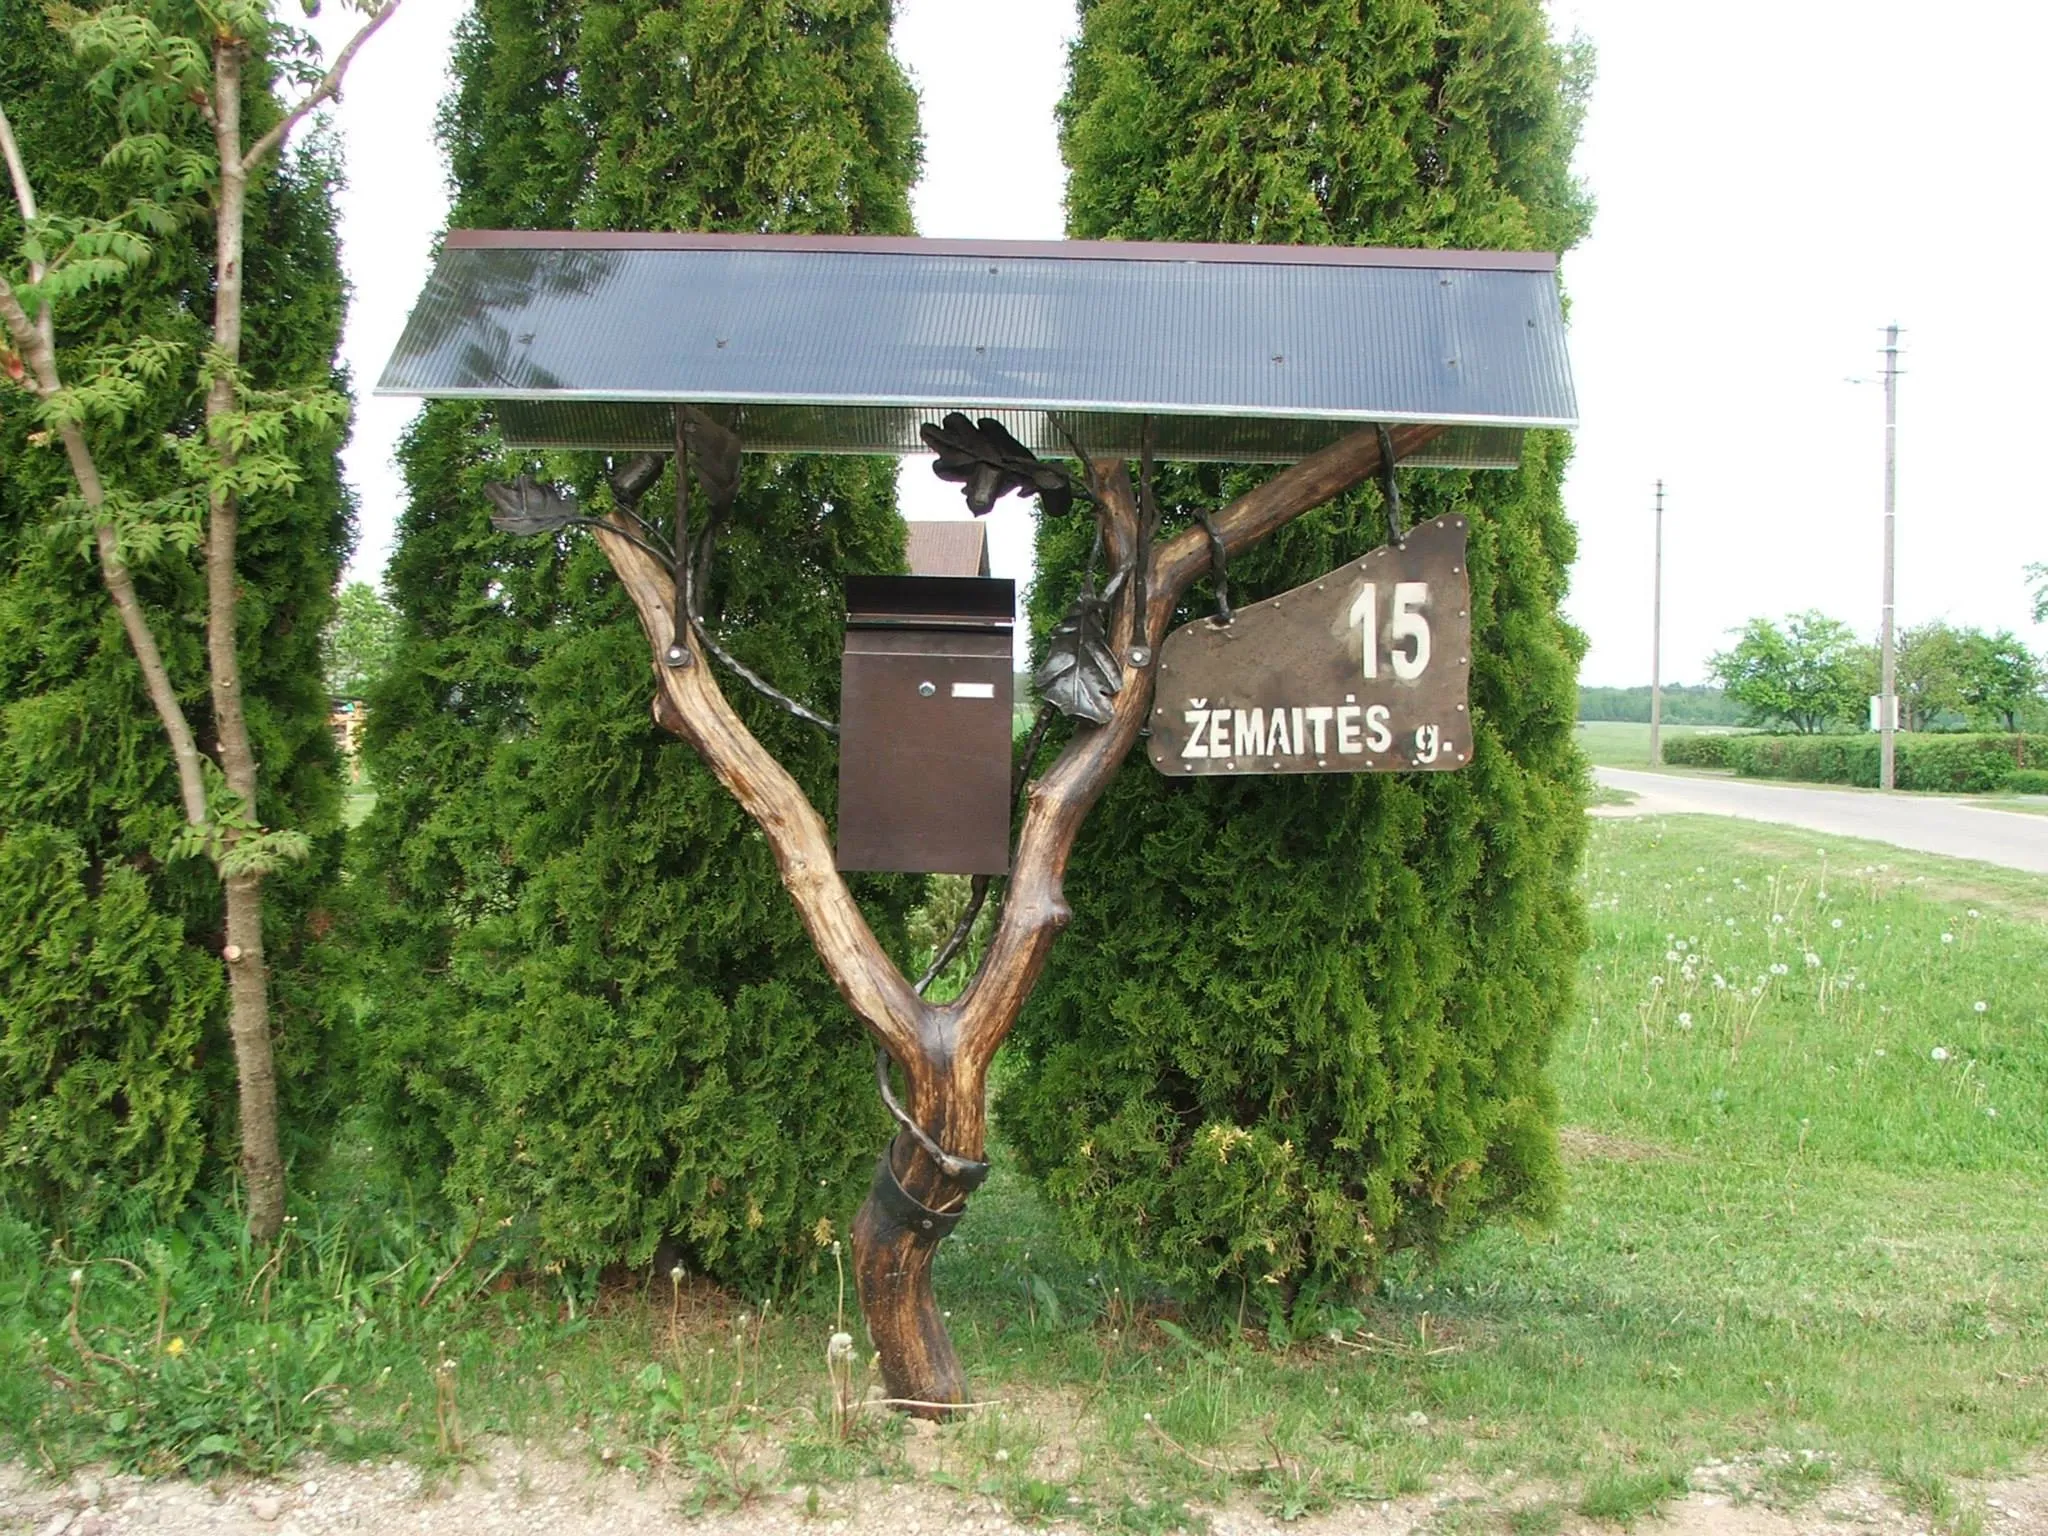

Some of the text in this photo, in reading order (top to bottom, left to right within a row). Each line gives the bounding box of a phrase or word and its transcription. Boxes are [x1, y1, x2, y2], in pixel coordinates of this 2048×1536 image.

[1349, 582, 1432, 680] 15
[1181, 694, 1453, 764] ŽEMAITĖS g.
